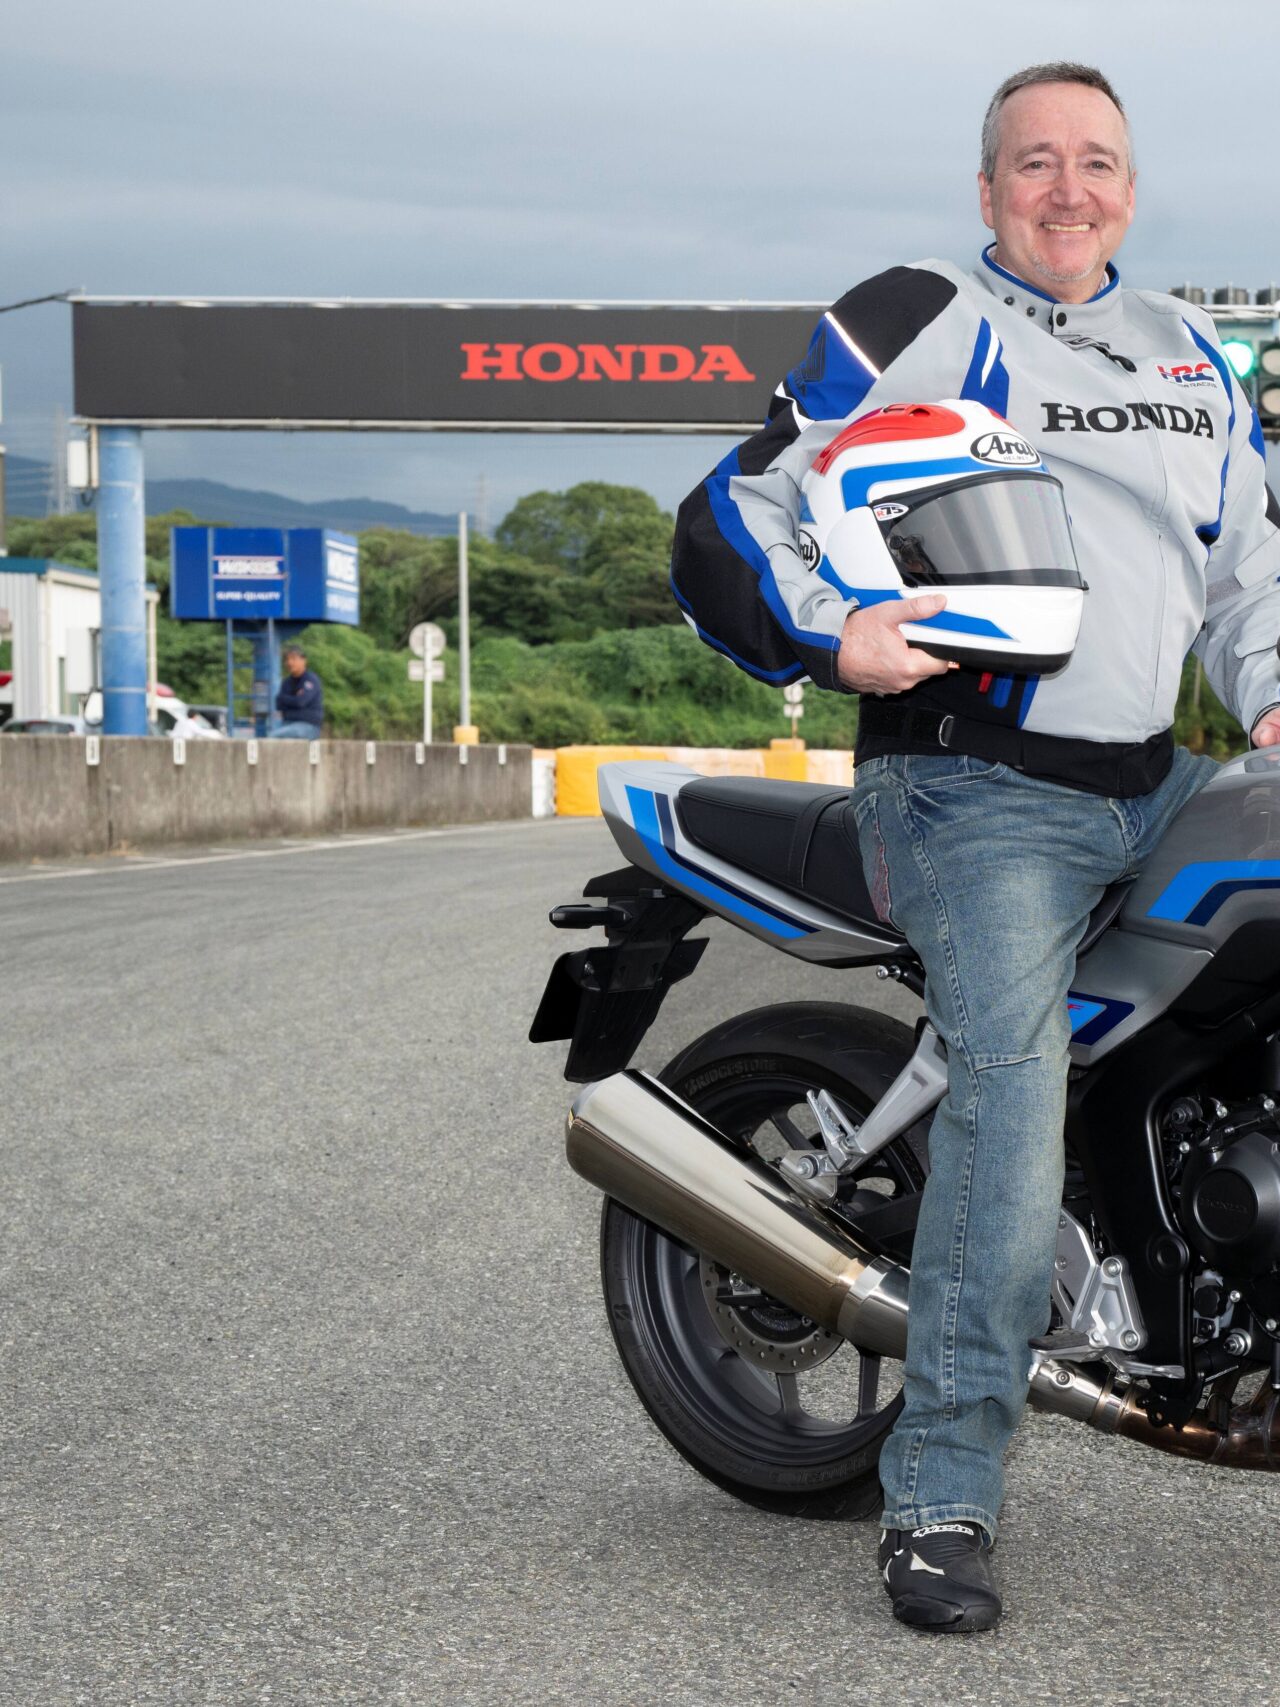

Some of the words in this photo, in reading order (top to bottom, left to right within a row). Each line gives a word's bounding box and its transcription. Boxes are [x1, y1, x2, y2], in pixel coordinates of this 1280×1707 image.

[460, 342, 756, 382] HONDA
[1157, 362, 1215, 383] HRC
[1041, 402, 1214, 440] HONDA
[980, 435, 1035, 457] Arai
